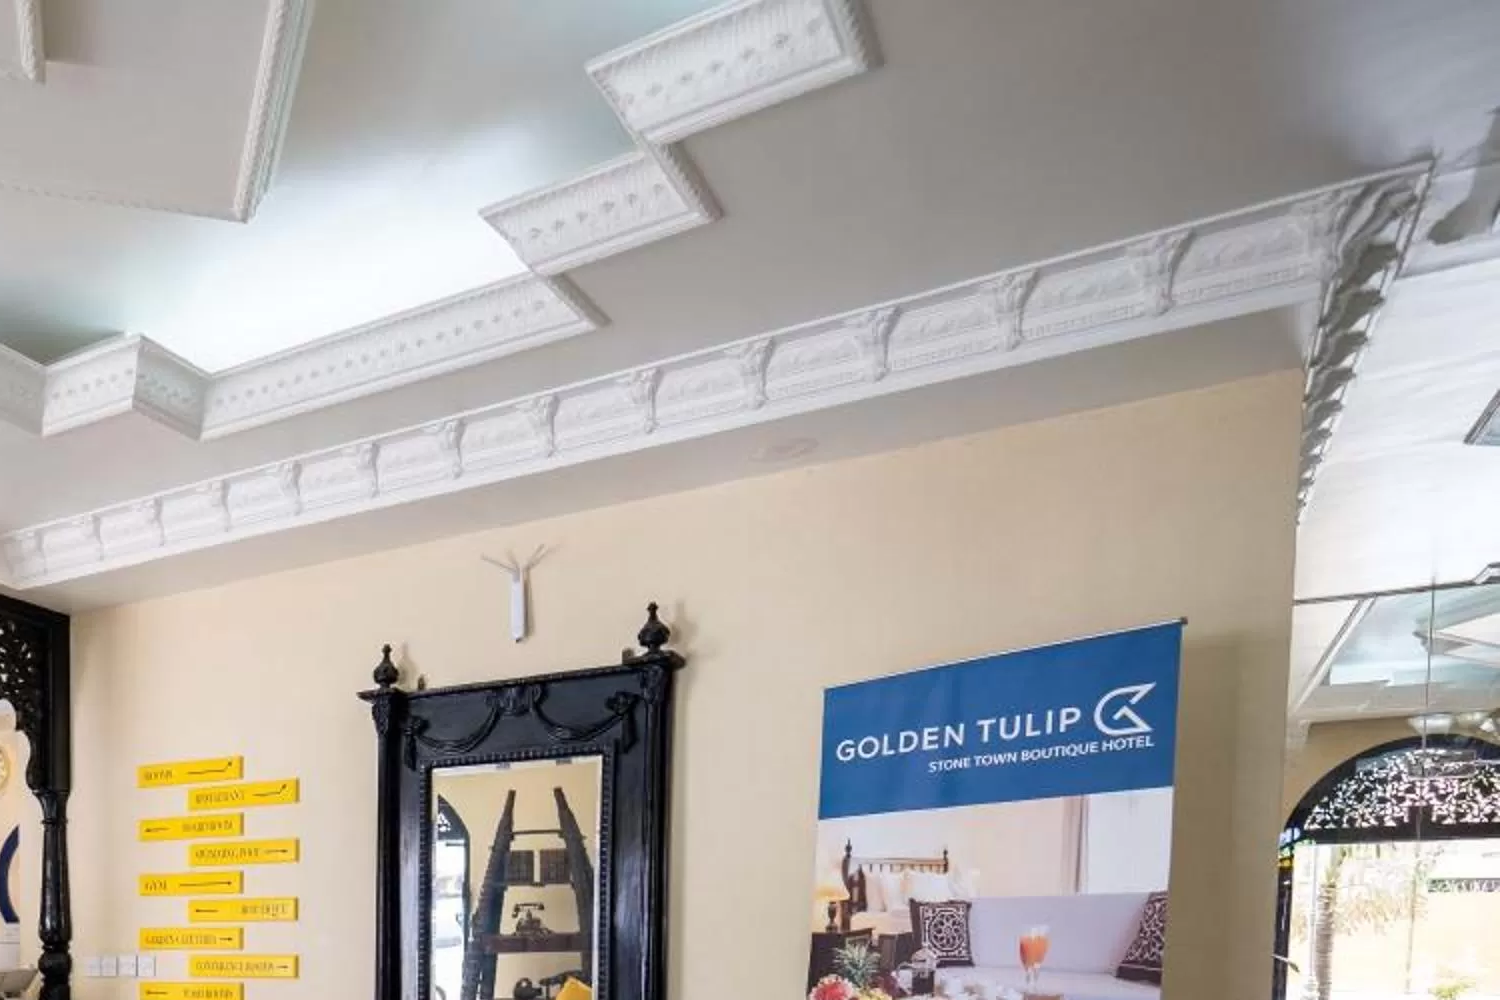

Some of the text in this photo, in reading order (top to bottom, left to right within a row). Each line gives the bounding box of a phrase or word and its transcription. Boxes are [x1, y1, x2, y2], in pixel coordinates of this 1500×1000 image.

[835, 706, 1082, 763] GOLDEN TULIP
[928, 735, 1155, 773] STONE TOWN BOUTIQUE HOTEL
